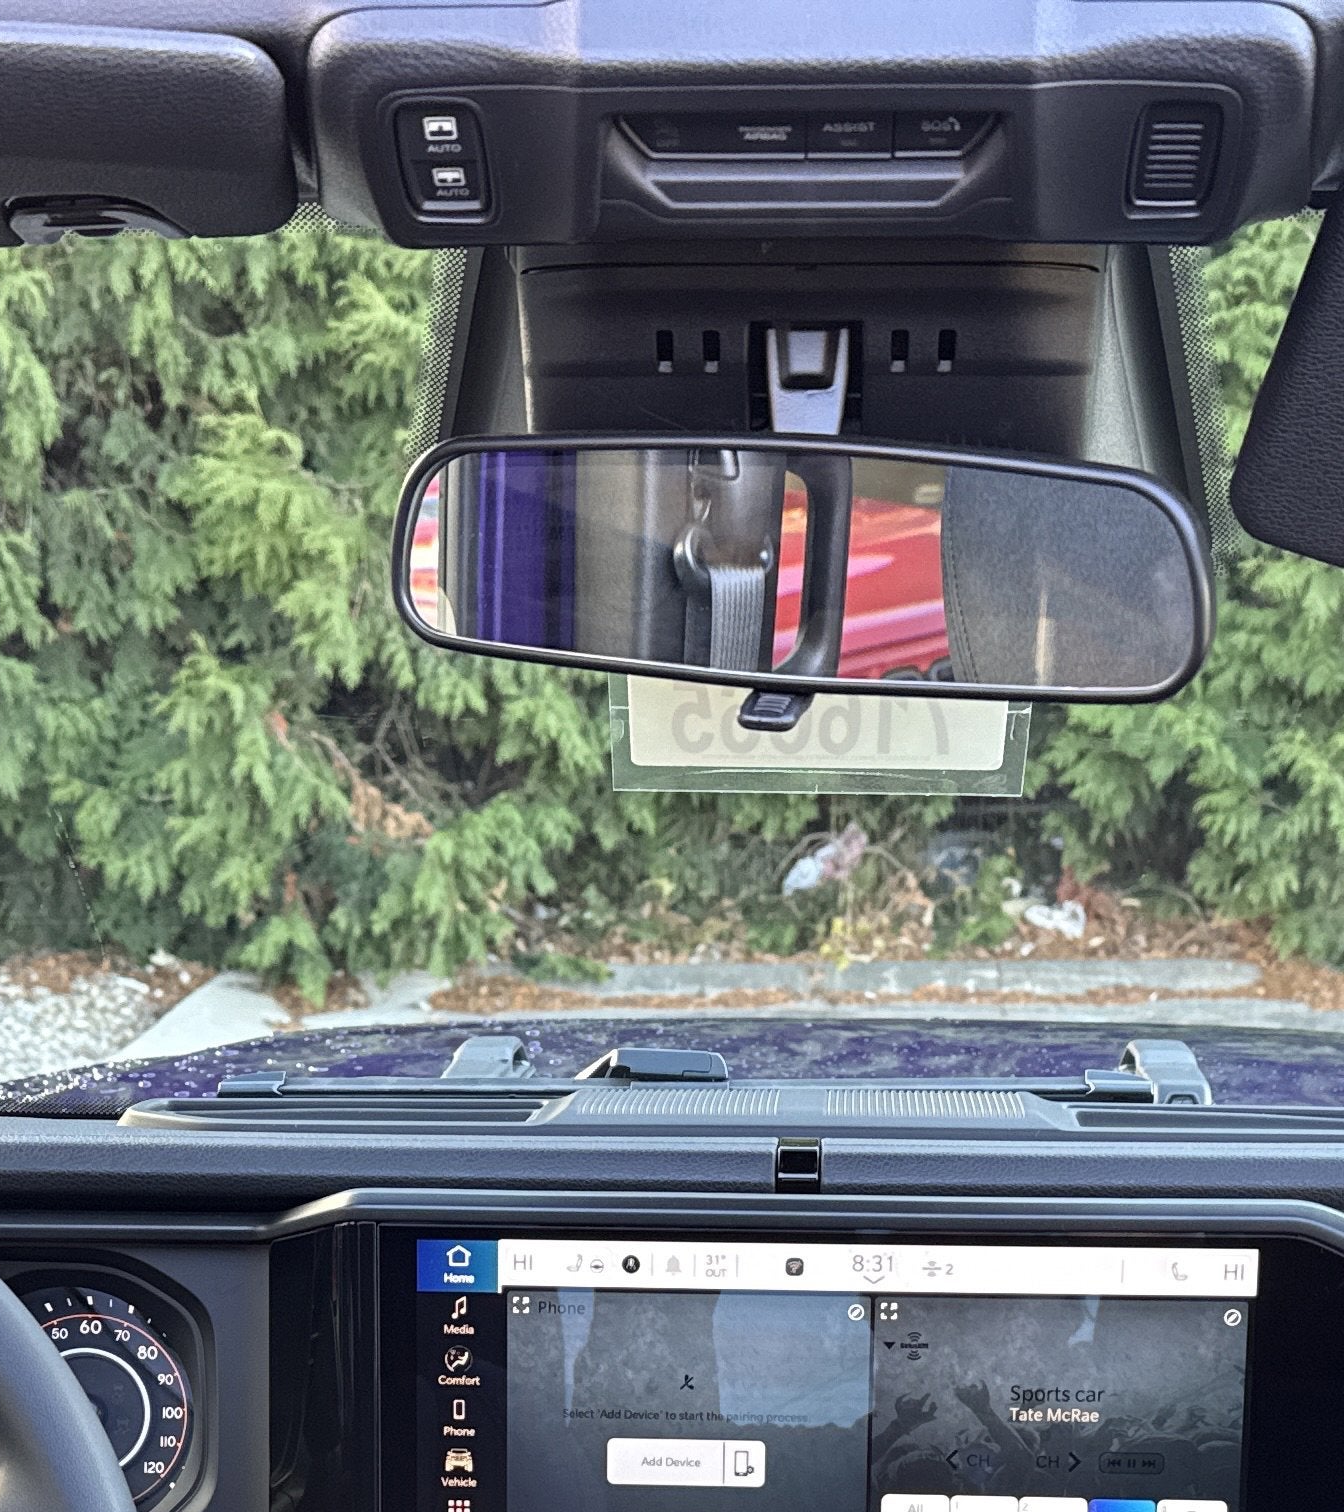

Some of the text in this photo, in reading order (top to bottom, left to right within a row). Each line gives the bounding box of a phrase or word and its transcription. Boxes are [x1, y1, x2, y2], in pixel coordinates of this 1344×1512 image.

[822, 121, 876, 132] ASSIST
[921, 120, 952, 132] SOS
[427, 143, 462, 154] AUTO
[436, 187, 470, 197] AUTO
[512, 1253, 535, 1272] HI
[852, 1254, 894, 1273] 8:31
[705, 1267, 728, 1278] OUT
[945, 1263, 954, 1276] 2
[1223, 1263, 1245, 1281] HI
[443, 1272, 475, 1285] Home
[537, 1300, 586, 1316] Phone
[51, 1327, 69, 1340] 50
[79, 1319, 102, 1335] 60
[443, 1323, 475, 1336] Media
[114, 1329, 131, 1342] 70
[137, 1345, 158, 1360] 80
[157, 1373, 174, 1386] 90
[438, 1374, 481, 1387] Comfort
[1010, 1385, 1105, 1406] Sports car
[162, 1406, 184, 1420] 100
[562, 1408, 595, 1419] Select
[665, 1411, 677, 1421] to
[679, 1411, 704, 1421] start
[707, 1411, 723, 1422] the
[726, 1412, 763, 1425] pairing
[1009, 1407, 1100, 1424] Tate McRae
[443, 1425, 476, 1437] Phone
[160, 1435, 177, 1448] 110
[641, 1456, 701, 1468] Add Device
[966, 1453, 991, 1467] CH
[1036, 1455, 1060, 1469] CH
[143, 1461, 165, 1474] 120
[441, 1475, 478, 1489] Vehicle
